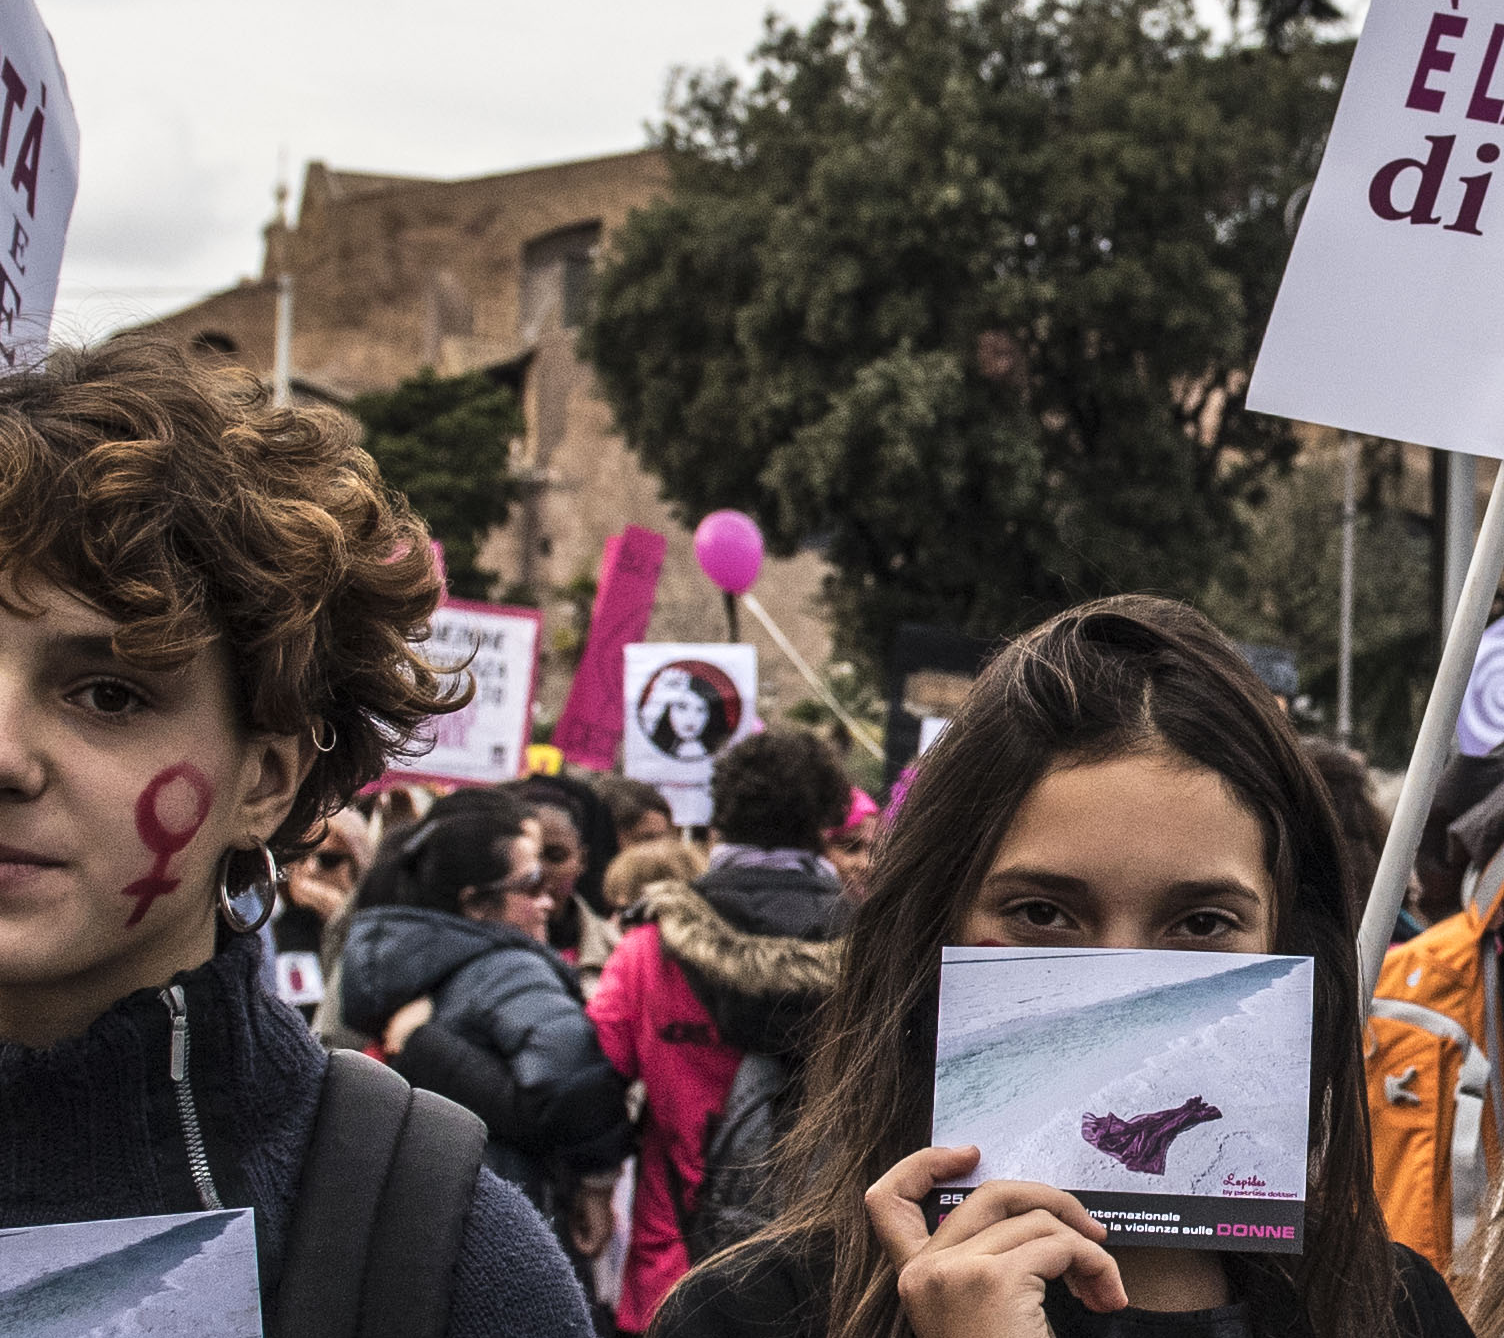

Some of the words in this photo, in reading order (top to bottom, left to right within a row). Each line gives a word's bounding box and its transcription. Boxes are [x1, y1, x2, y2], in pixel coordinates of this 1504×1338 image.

[1368, 134, 1501, 236] di
[1110, 1222, 1121, 1231] la
[1125, 1223, 1179, 1234] violenza
[1182, 1226, 1213, 1235] sulle
[1216, 1223, 1295, 1239] DONNE
